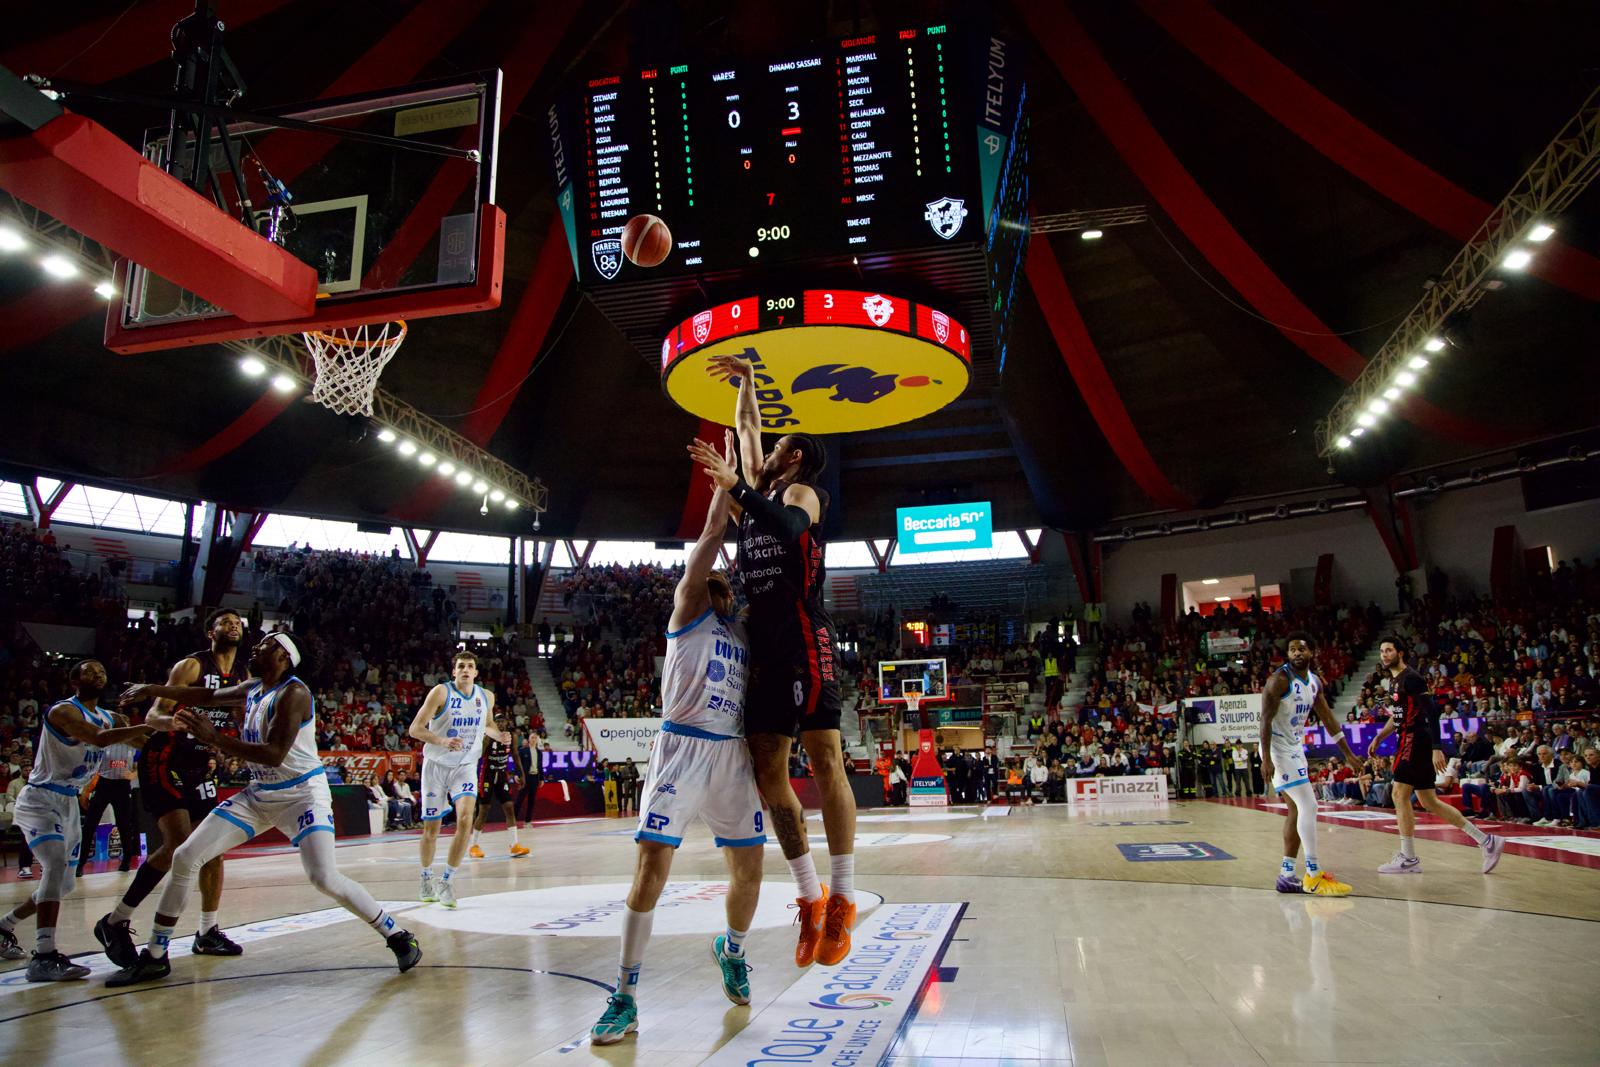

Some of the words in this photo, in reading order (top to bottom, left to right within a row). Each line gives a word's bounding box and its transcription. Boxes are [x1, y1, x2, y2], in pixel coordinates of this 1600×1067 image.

[927, 25, 946, 35] PUNTI
[846, 53, 877, 63] MARSHALL
[768, 62, 796, 72] DINAMO
[796, 58, 821, 68] SASSARI
[712, 71, 736, 82] VARESE
[848, 76, 870, 85] MACON
[985, 37, 1006, 126] ITELYUM
[848, 87, 872, 96] ZANELLI
[593, 93, 618, 102] STEWART
[849, 99, 864, 107] SECK
[788, 102, 800, 120] 3
[850, 107, 885, 118] BELIAUSKAS
[595, 115, 615, 124] MOORE
[728, 110, 740, 128] 0
[851, 120, 871, 129] CERON
[548, 104, 568, 187] ITELYUM
[852, 142, 875, 151] VINCINI
[788, 154, 796, 164] 0
[854, 151, 892, 162] MEZZANOTTE
[744, 160, 751, 170] 0
[854, 164, 879, 173] THOMAS
[599, 178, 621, 186] RENFRO
[855, 174, 883, 183] MCGLYNN
[600, 188, 628, 197] BERGAMIN
[856, 194, 875, 202] MRSIC
[601, 198, 630, 207] LADURNER
[766, 193, 776, 206] 7
[602, 209, 627, 218] FREEMAN
[847, 218, 870, 227] TIME-OUT
[756, 225, 790, 242] 9:00
[594, 242, 620, 252] VARESE
[678, 240, 700, 248] TIME-OUT
[766, 297, 796, 311] 9:00
[824, 294, 834, 308] 3
[732, 304, 741, 318] 0
[778, 316, 784, 326] 7
[904, 513, 960, 531] Beccaria
[906, 622, 925, 631] 9:00
[914, 630, 924, 644] 7
[816, 627, 834, 681] VARESE
[204, 674, 220, 689] 15
[793, 680, 804, 706] 8
[1294, 684, 1300, 694] 2
[450, 698, 462, 708] 22
[1220, 700, 1247, 712] Agenzia
[1220, 712, 1254, 724] SVILUPPO
[196, 781, 218, 800] 15
[462, 783, 474, 792] 22
[1100, 777, 1159, 794] Finazzi
[298, 810, 314, 830] 25
[646, 812, 670, 830] EP
[754, 811, 764, 832] 9
[72, 842, 80, 858] 4
[822, 944, 902, 991] acinque
[857, 1019, 882, 1050] UNISCE
